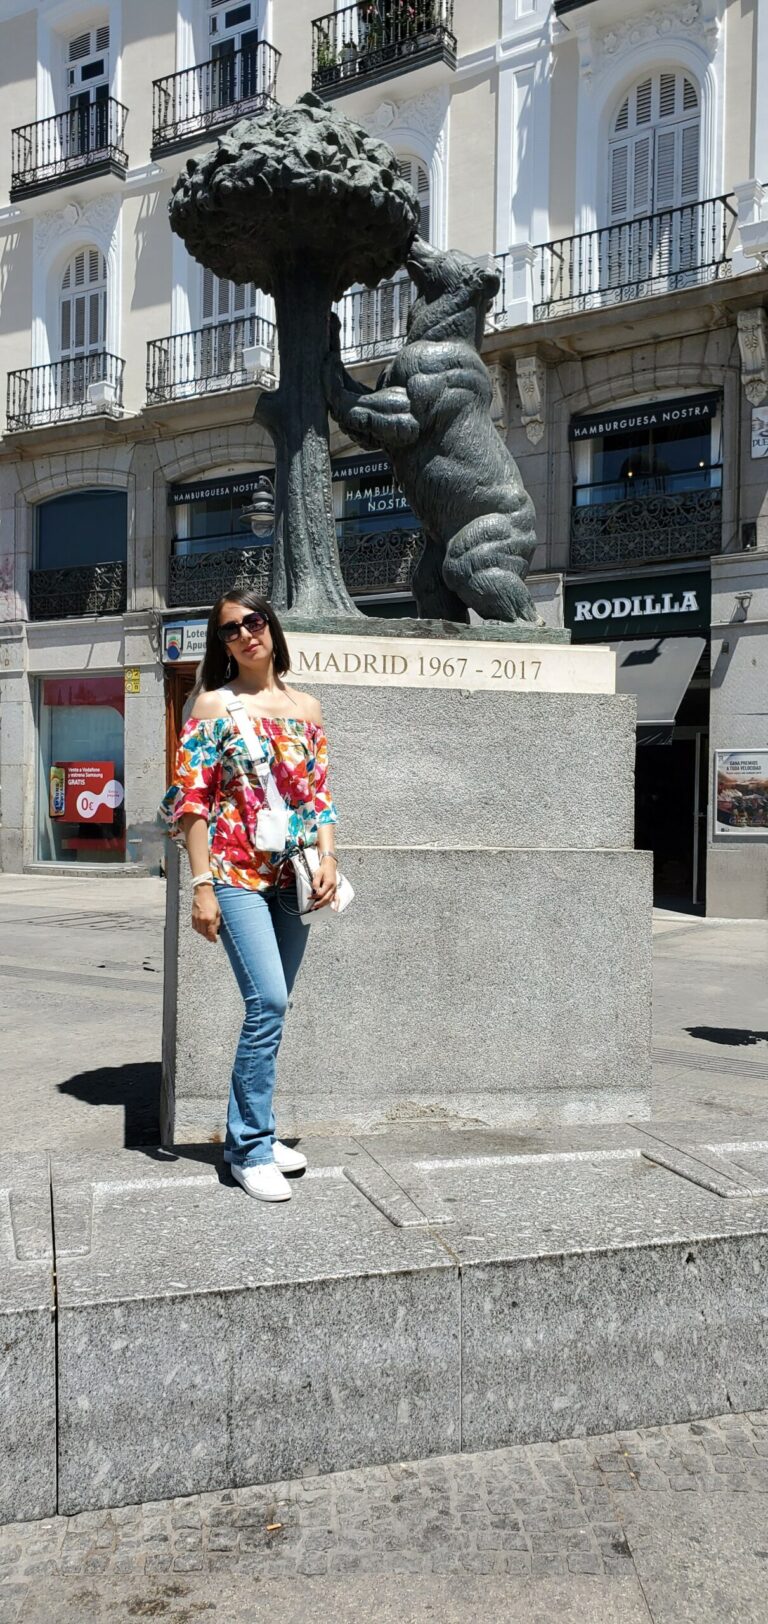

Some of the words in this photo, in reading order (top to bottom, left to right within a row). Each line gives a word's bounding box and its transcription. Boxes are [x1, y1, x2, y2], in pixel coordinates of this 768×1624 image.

[574, 415, 657, 436] HAMBURGUESA
[662, 405, 709, 421] NOSTRA
[331, 462, 390, 477] AMBURGUES
[174, 487, 230, 502] HAMBURGUESA
[233, 482, 261, 492] NOSTR
[368, 497, 410, 512] NOSTR
[574, 591, 699, 621] RODILLA
[299, 651, 408, 674] MADRID
[418, 655, 467, 678] 1967
[491, 659, 542, 680] 2017
